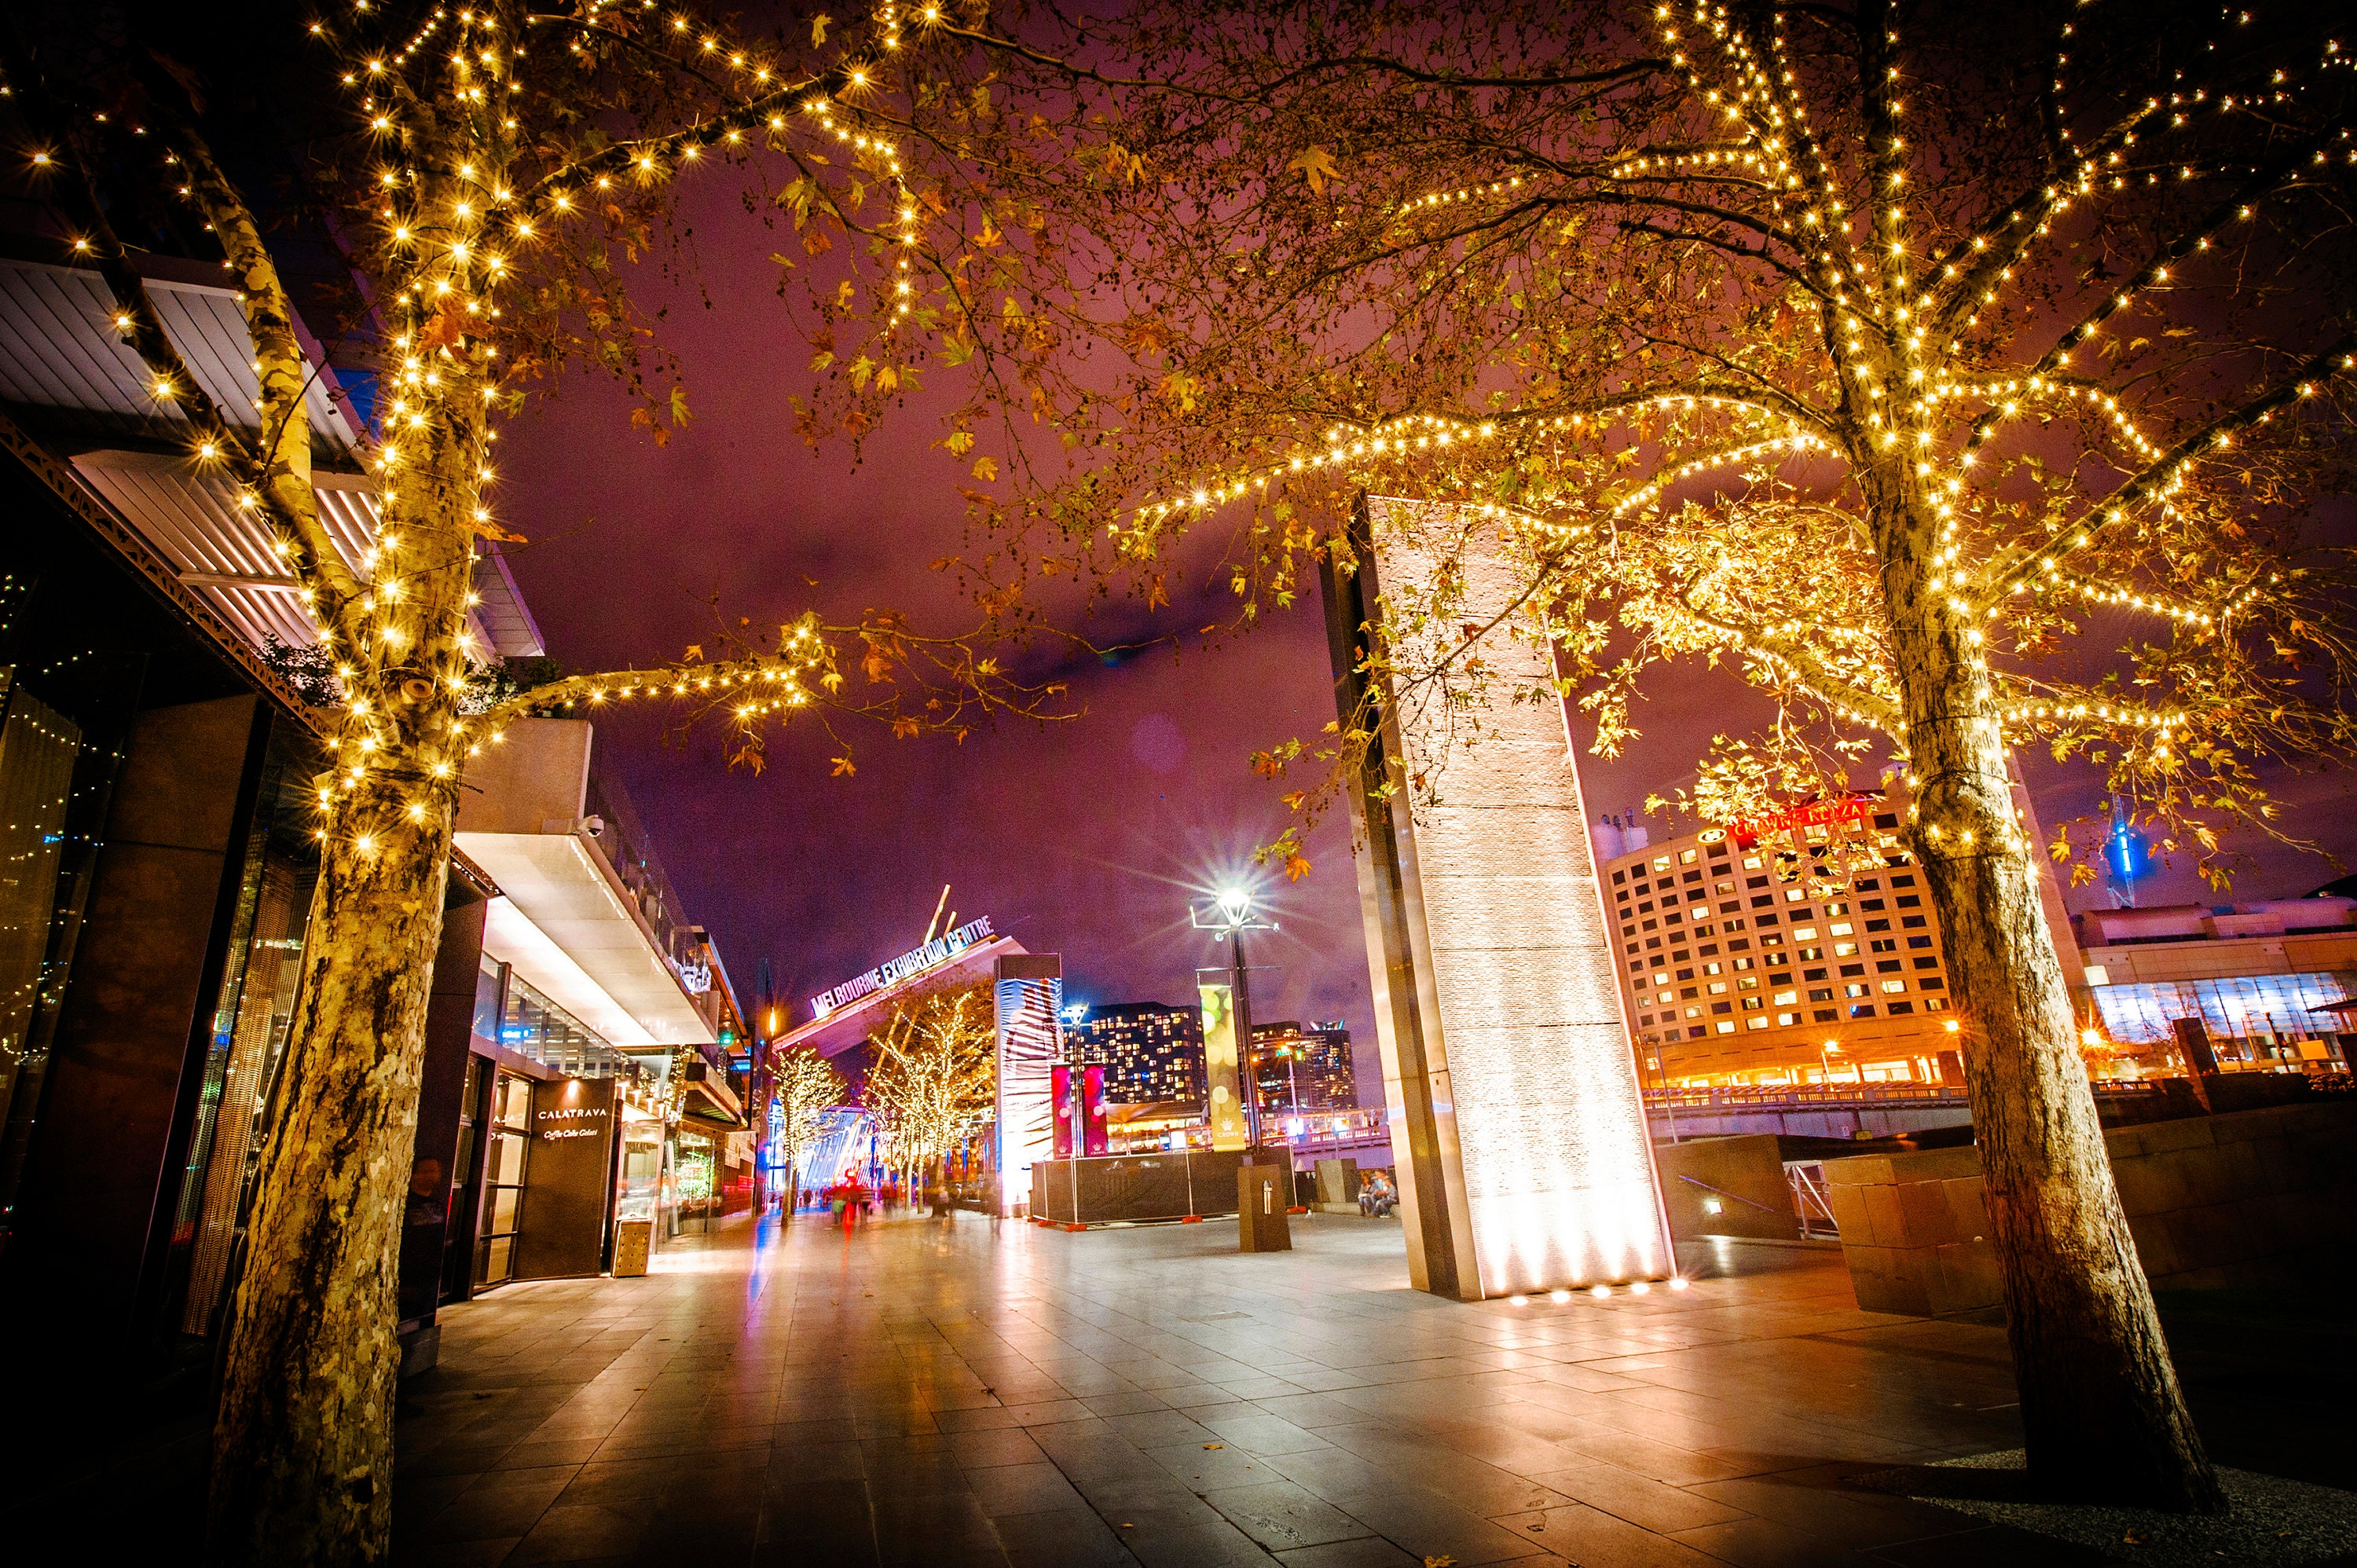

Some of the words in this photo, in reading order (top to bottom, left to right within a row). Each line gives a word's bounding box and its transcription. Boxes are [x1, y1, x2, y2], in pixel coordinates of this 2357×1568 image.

[810, 967, 883, 1018] MELBOURNE
[881, 936, 948, 984] EXHIBITION
[946, 915, 995, 952] CENTRE
[538, 1108, 607, 1119] CALATRAVA
[544, 1130, 563, 1140] Coffee
[563, 1129, 578, 1138] Cake
